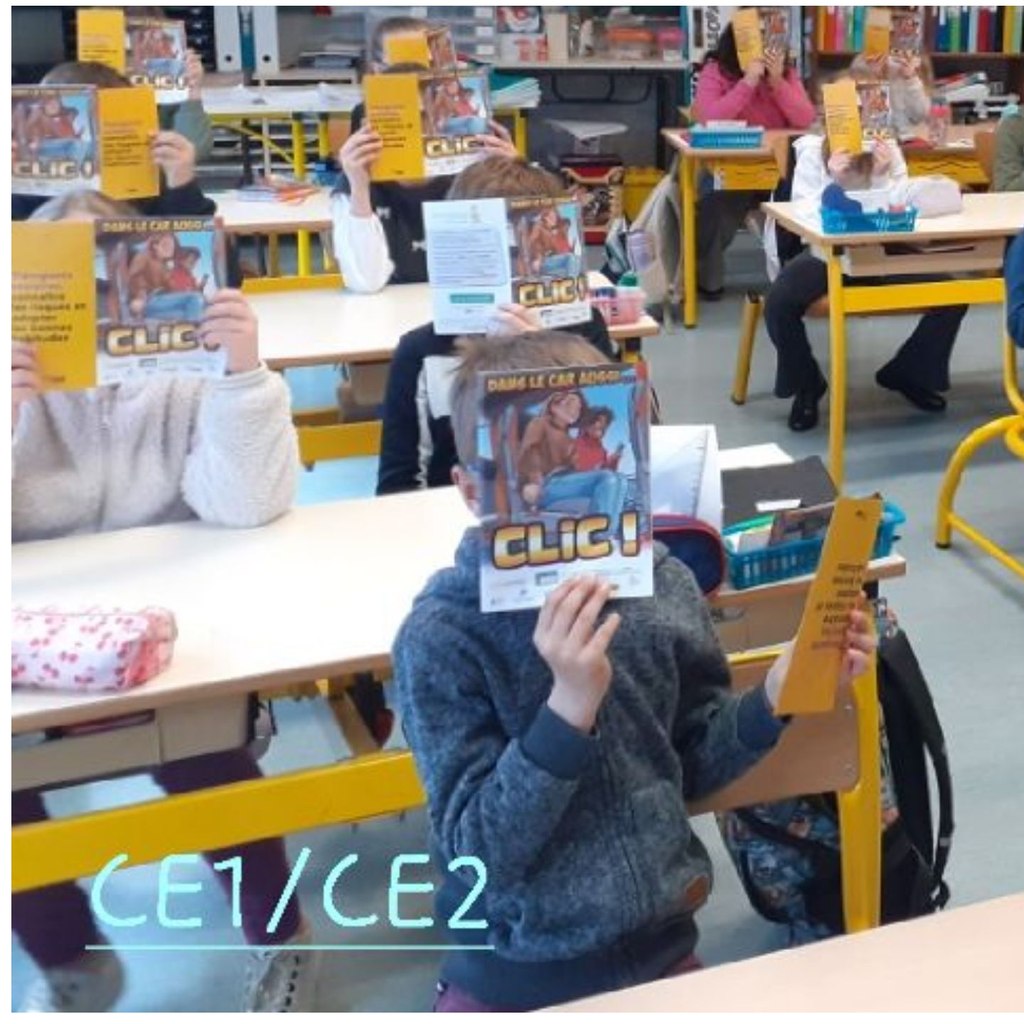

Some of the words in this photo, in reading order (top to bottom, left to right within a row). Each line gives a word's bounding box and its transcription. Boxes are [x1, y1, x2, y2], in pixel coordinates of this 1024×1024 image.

[487, 376, 526, 392] DANS
[529, 375, 545, 389] LE
[549, 372, 575, 387] CAR
